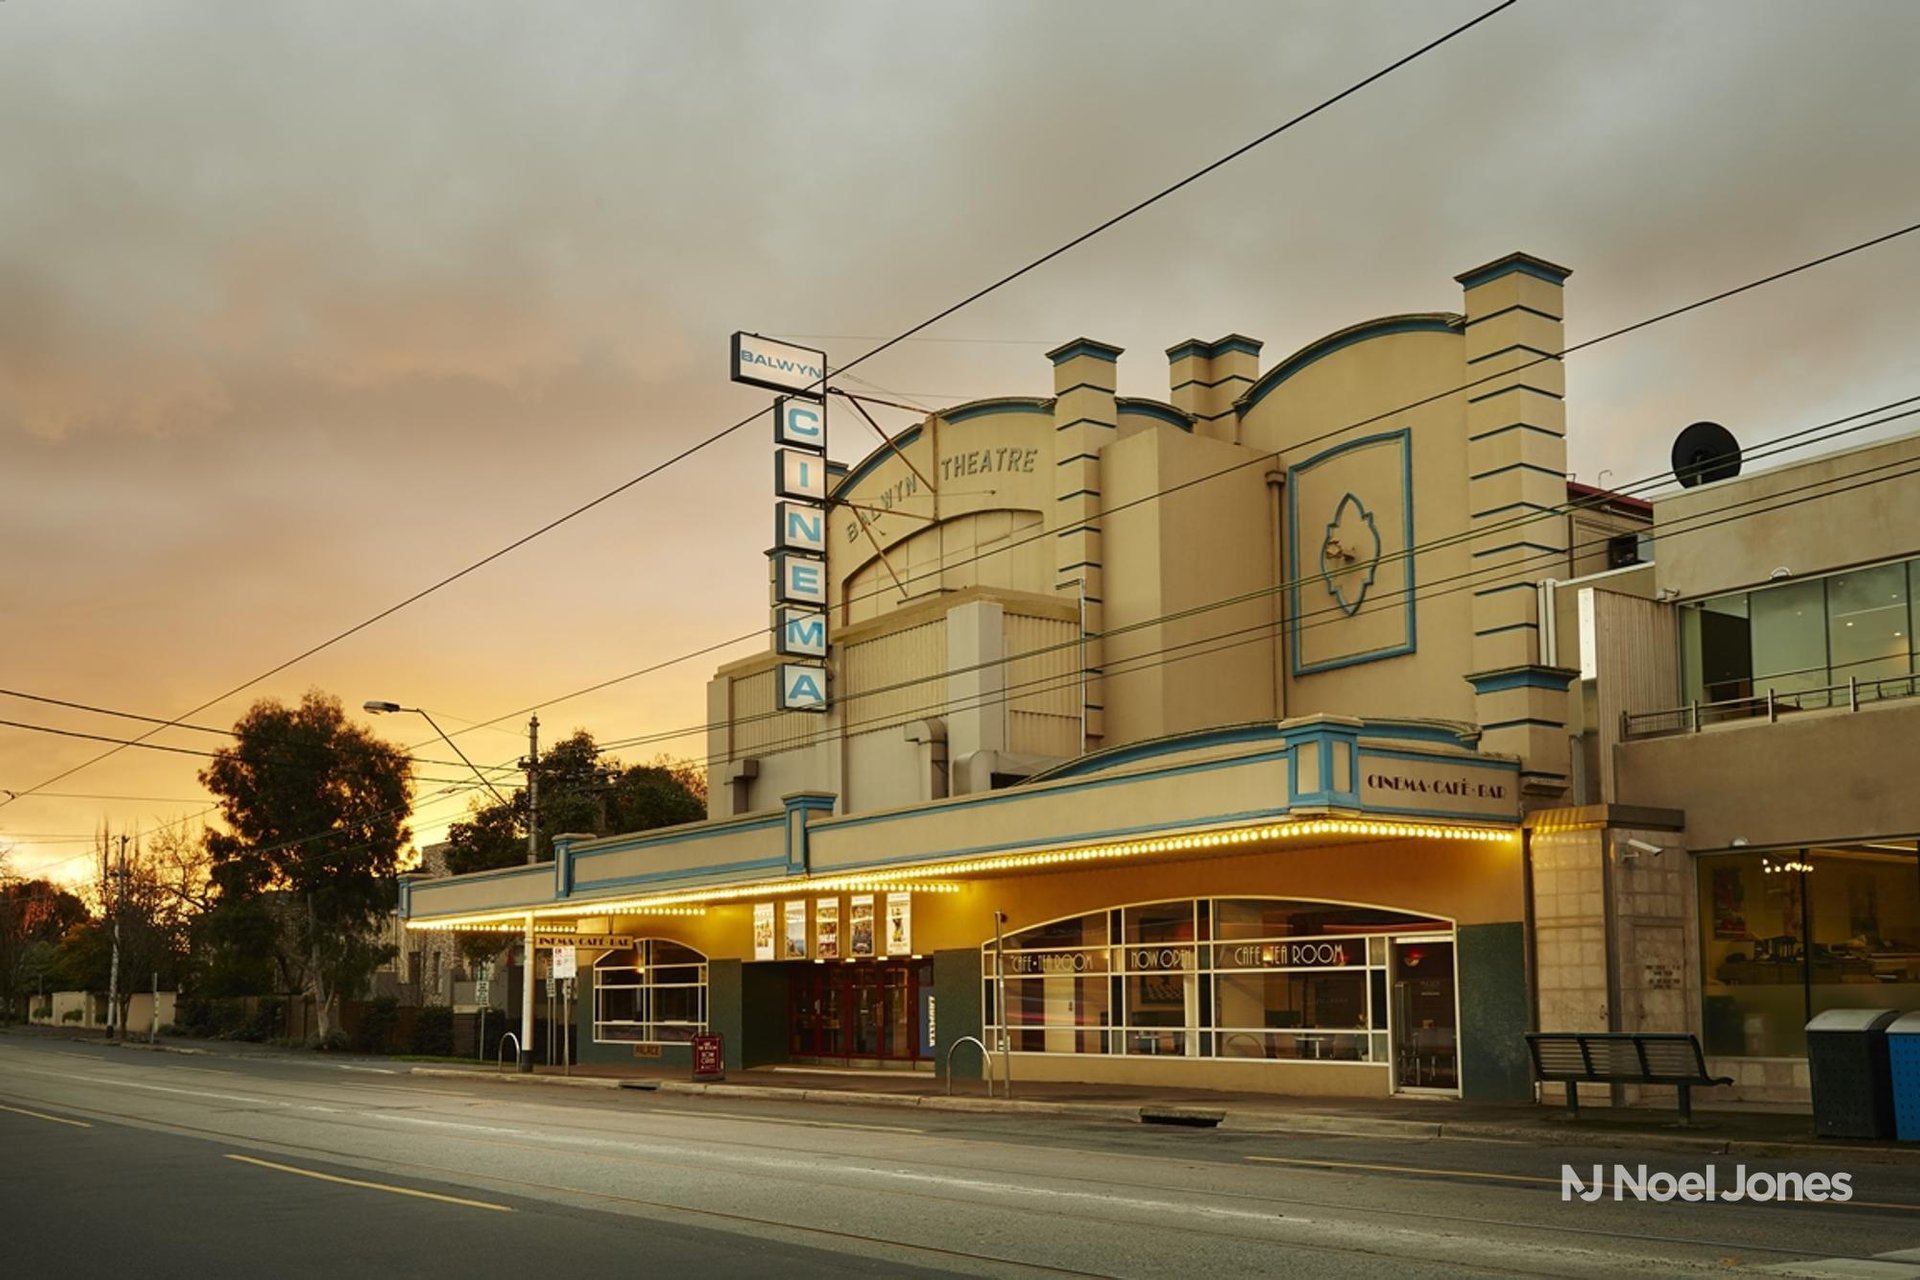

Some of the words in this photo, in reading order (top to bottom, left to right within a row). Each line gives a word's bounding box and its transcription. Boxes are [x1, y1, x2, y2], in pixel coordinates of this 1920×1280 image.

[741, 350, 822, 379] BALWYN
[846, 473, 918, 543] BALWYN
[941, 448, 1038, 481] THEATRE
[788, 407, 824, 701] CINEMA
[1367, 774, 1427, 793] CINEMA
[1433, 777, 1471, 796] CAFÉ
[1478, 784, 1506, 799] BAR
[1055, 951, 1094, 972] ROOM
[1131, 950, 1158, 969] NOW
[1234, 946, 1261, 966] CAFE
[1269, 945, 1288, 965] TEA
[1292, 943, 1345, 966] ROOM
